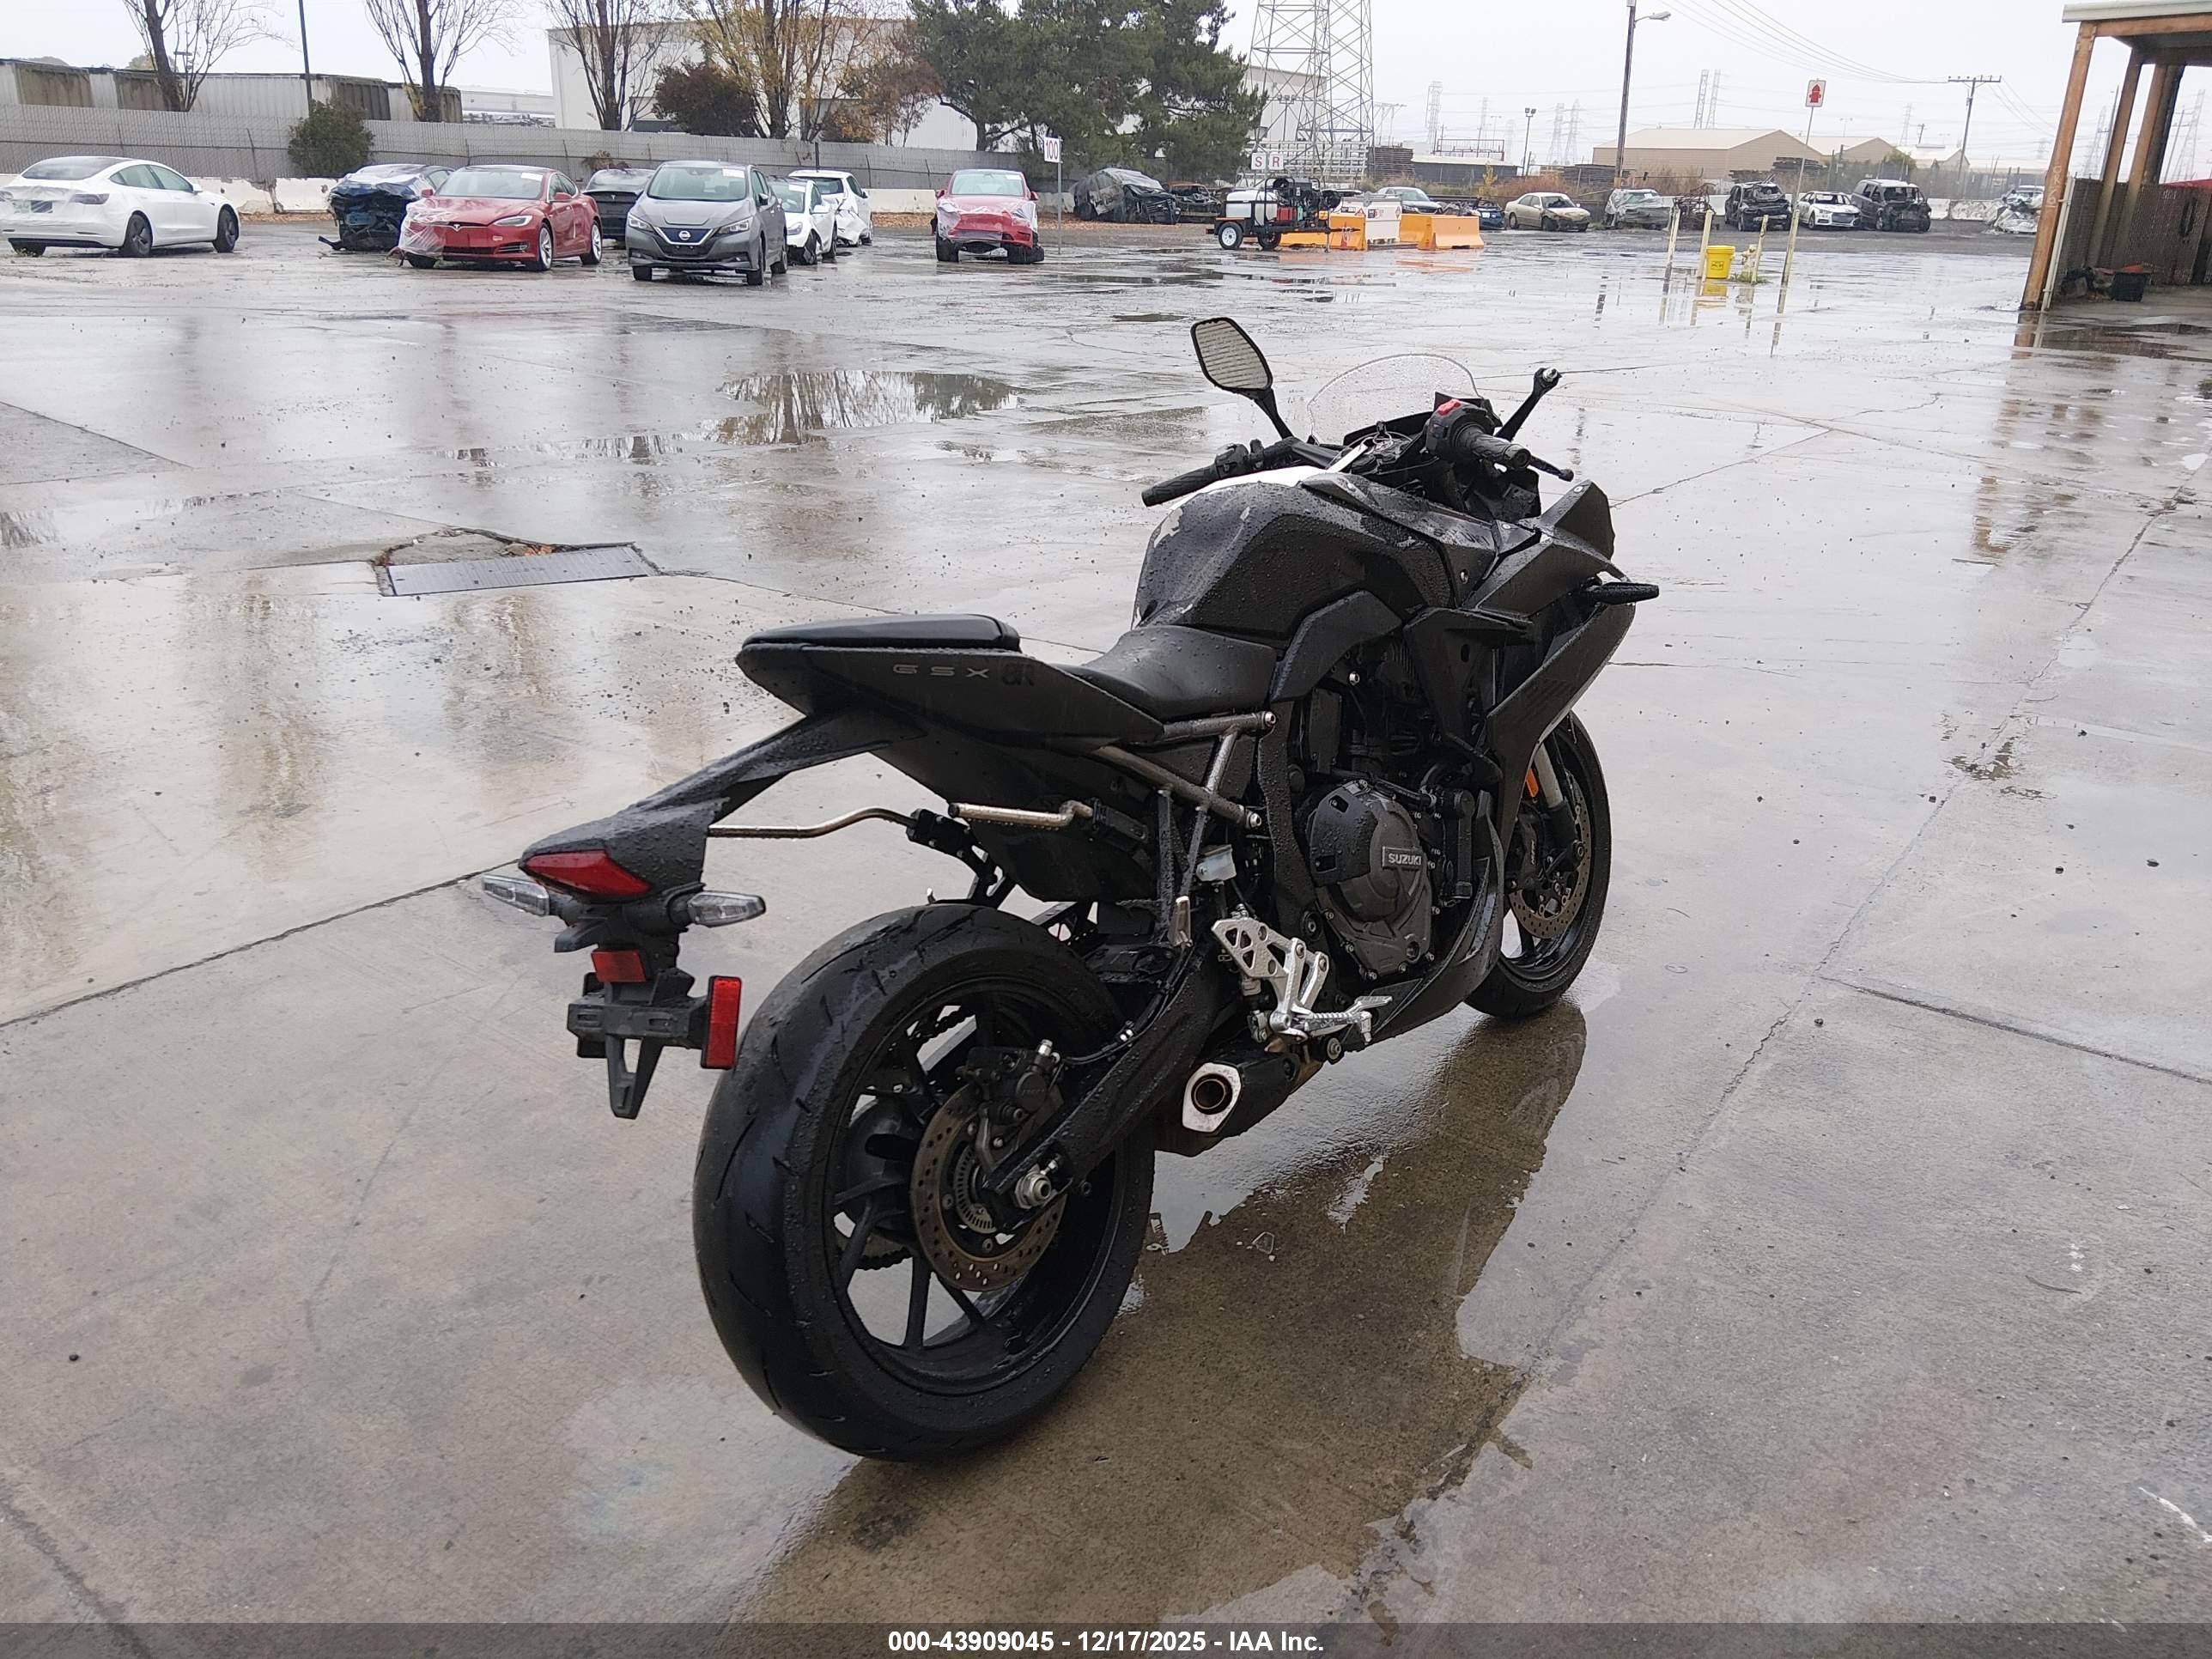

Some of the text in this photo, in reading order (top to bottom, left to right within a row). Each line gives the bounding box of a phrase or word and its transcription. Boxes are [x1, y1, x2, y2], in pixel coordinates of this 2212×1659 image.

[1045, 140, 1058, 160] 100
[1255, 156, 1262, 167] S
[1272, 156, 1280, 167] R
[892, 664, 989, 678] GSX
[1388, 853, 1422, 866] SUZUKI
